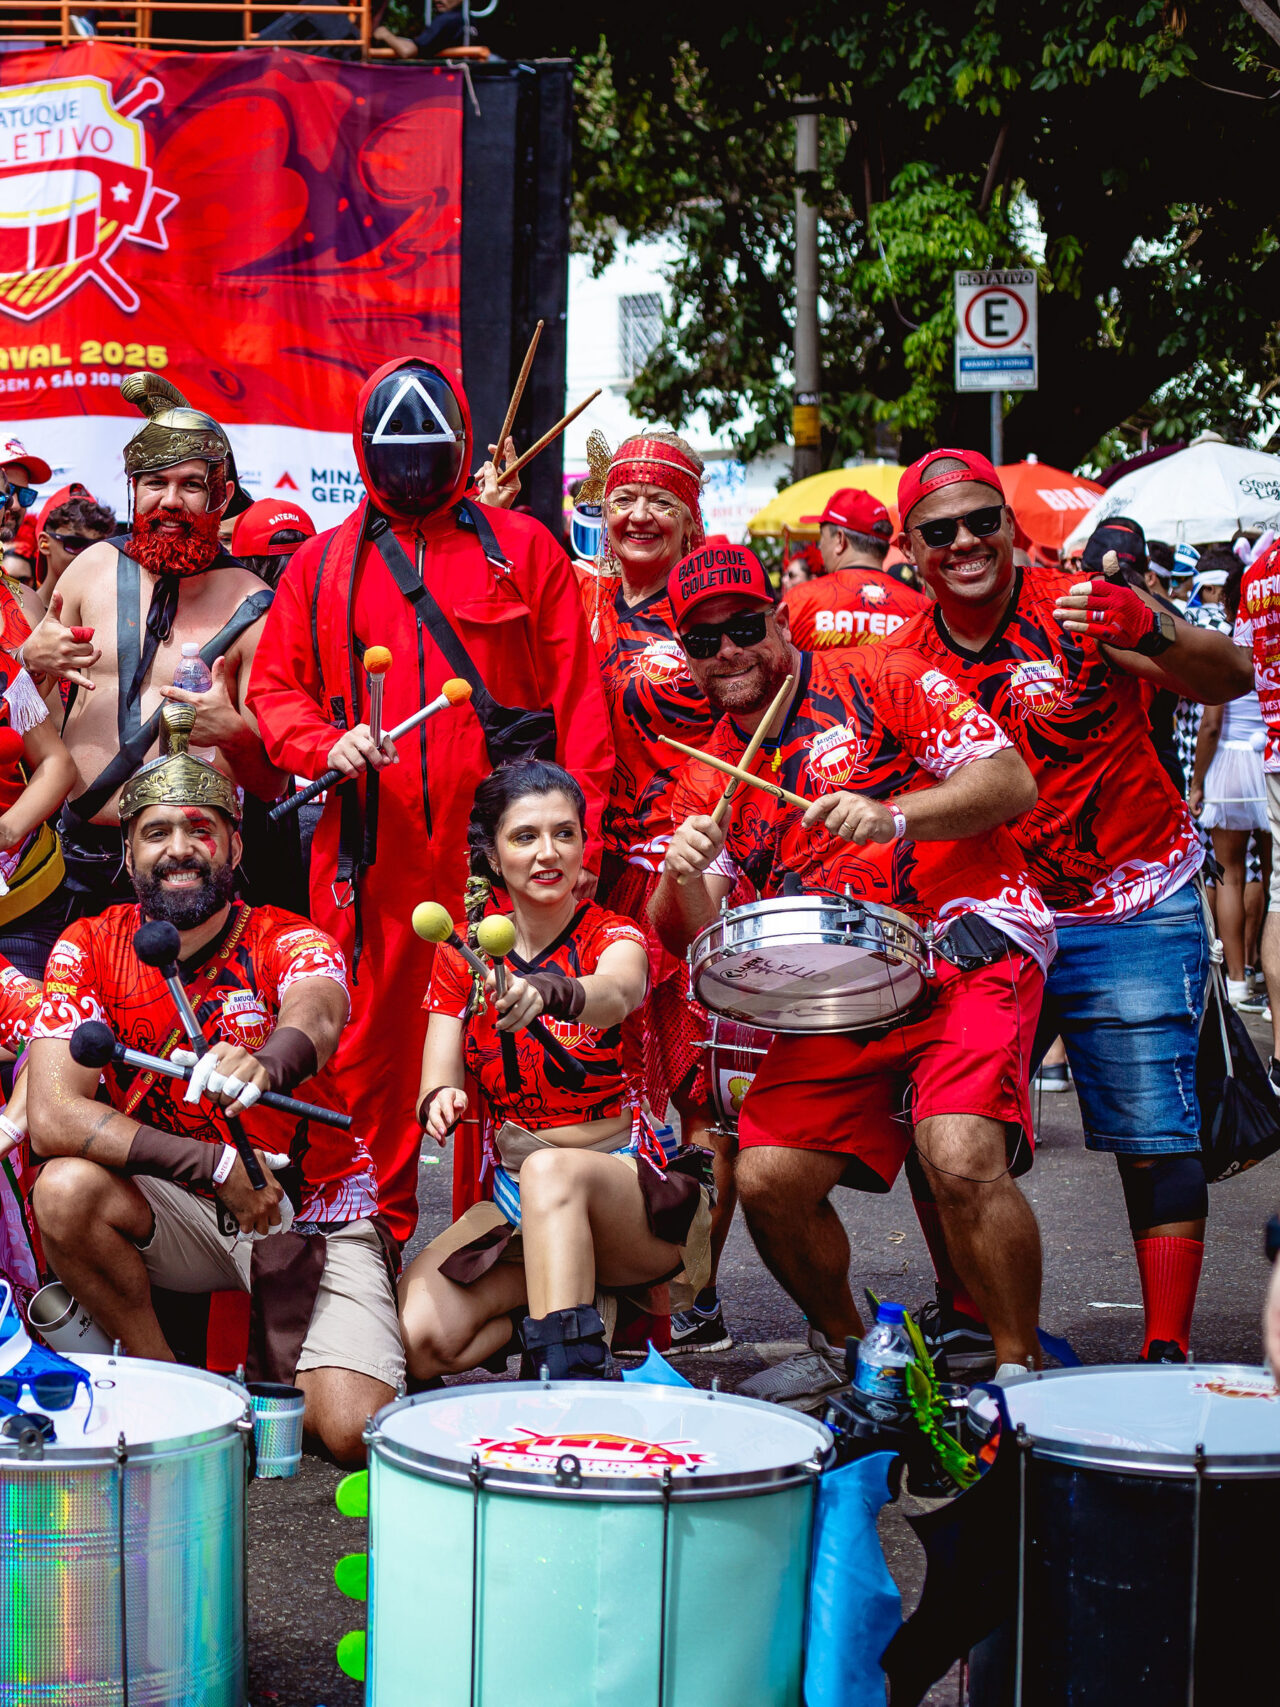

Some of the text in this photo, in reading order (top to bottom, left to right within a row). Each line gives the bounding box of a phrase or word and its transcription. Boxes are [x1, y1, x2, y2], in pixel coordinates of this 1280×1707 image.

[959, 271, 1034, 286] ROTATIVO
[984, 298, 1009, 337] E
[80, 340, 168, 369] 2025
[33, 377, 47, 390] A
[50, 370, 87, 388] SÃO
[90, 372, 130, 388] JOR
[310, 468, 365, 485] MINA
[311, 486, 367, 504] GERA
[1036, 487, 1104, 511] BRA
[268, 512, 300, 526] BATERIA
[678, 549, 747, 582] BATUQUE
[681, 566, 752, 601] COLETIVO
[815, 610, 911, 636] BATER
[1023, 665, 1047, 674] ATUQUE
[816, 730, 839, 746] BATUQUE
[46, 981, 78, 997] DESDE
[26, 992, 43, 1009] DES
[51, 993, 69, 1003] 2017
